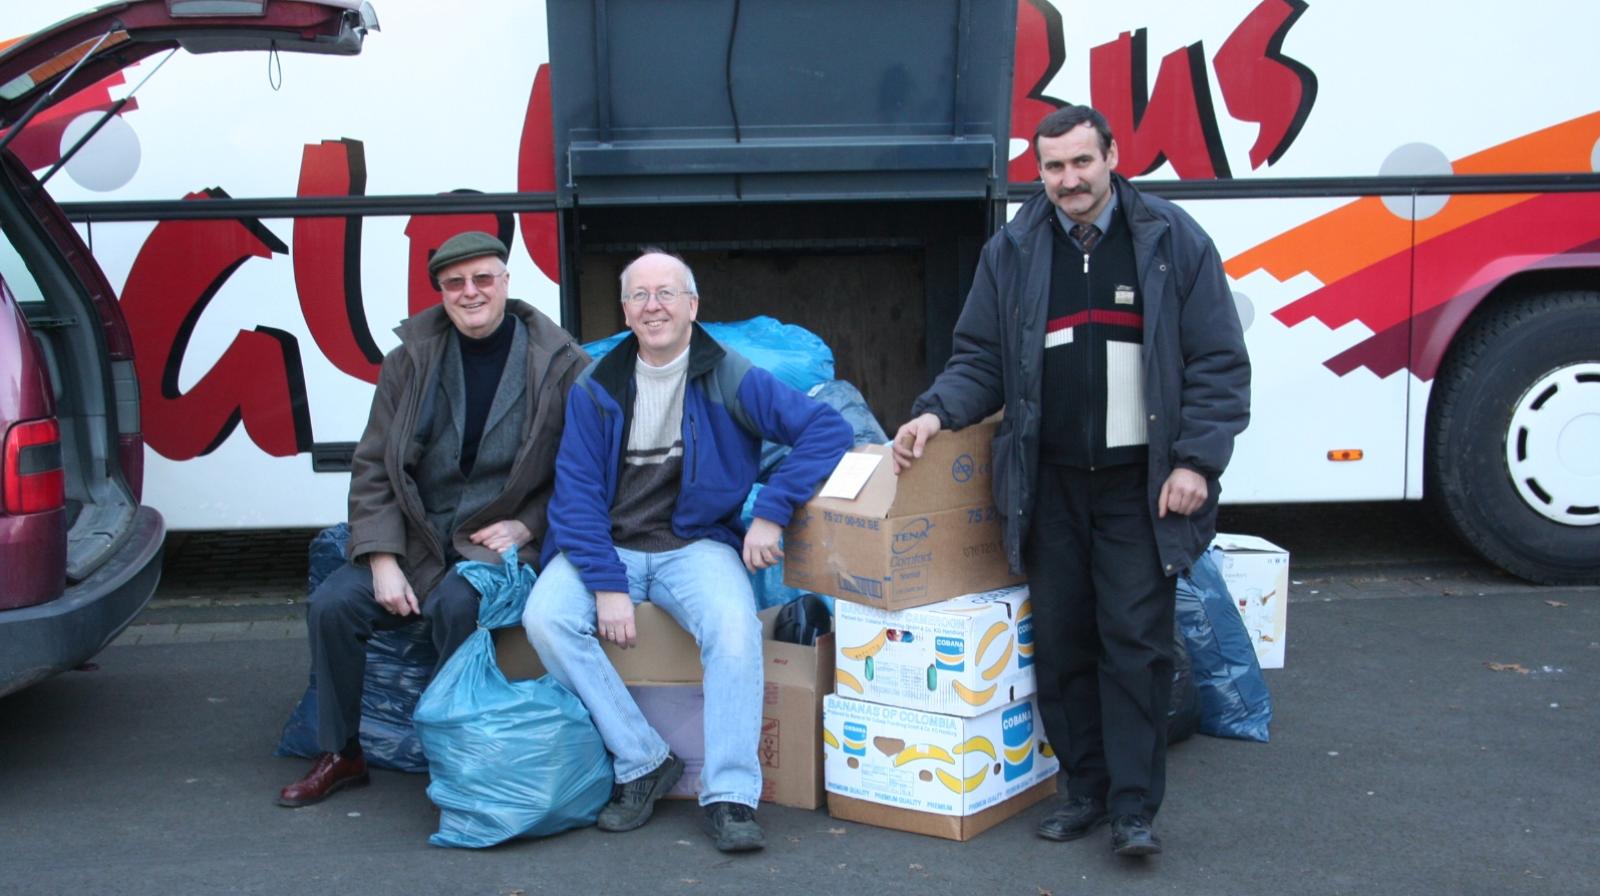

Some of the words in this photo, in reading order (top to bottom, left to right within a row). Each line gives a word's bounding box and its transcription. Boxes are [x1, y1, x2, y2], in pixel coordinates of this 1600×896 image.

[893, 530, 929, 543] TENA
[936, 638, 964, 649] COBANA
[828, 698, 881, 717] BANANAS
[882, 708, 897, 720] OF
[899, 710, 958, 731] COLOMBIA
[1003, 709, 1032, 730] COBANA
